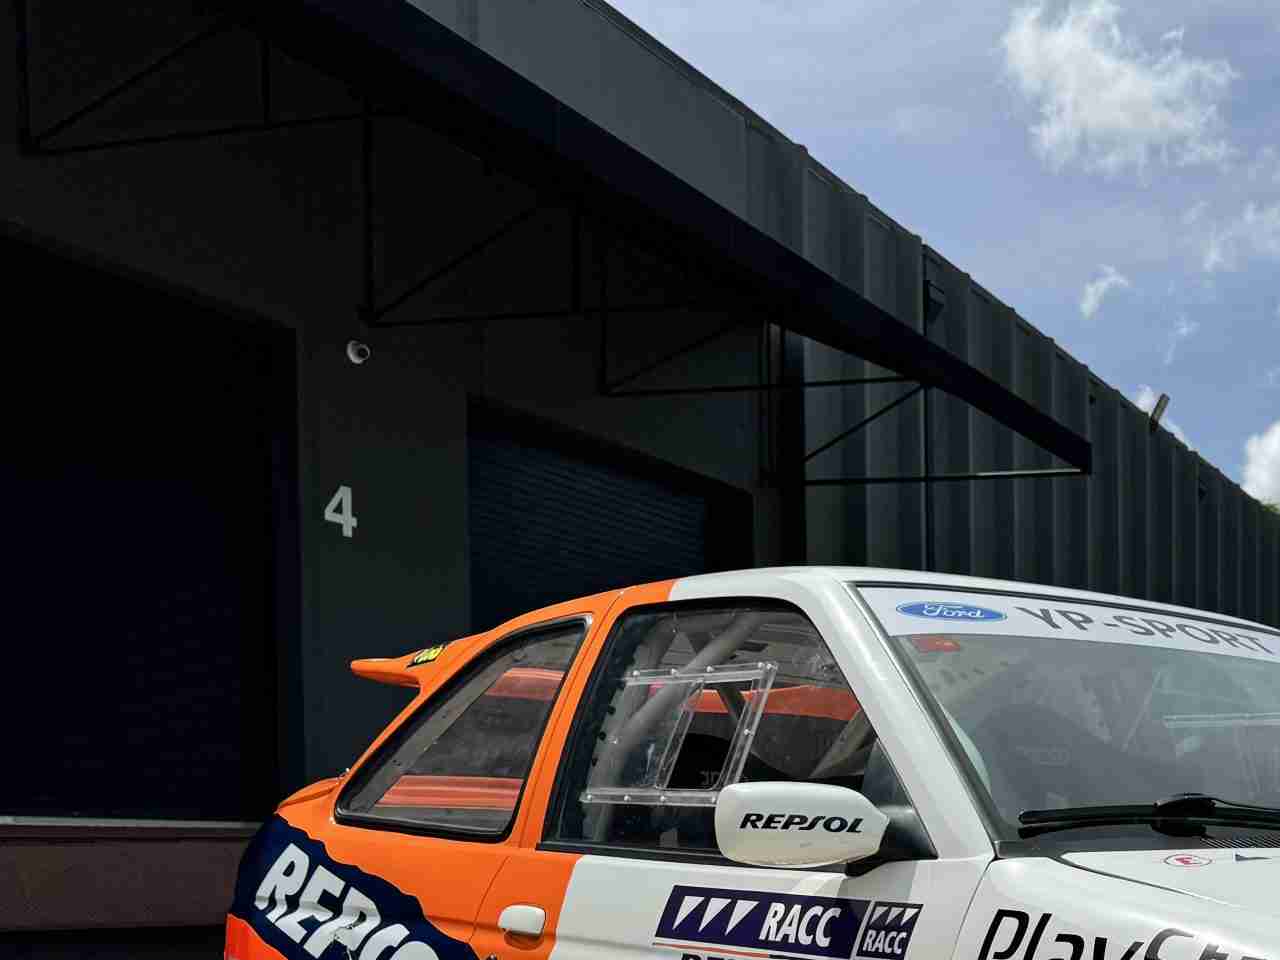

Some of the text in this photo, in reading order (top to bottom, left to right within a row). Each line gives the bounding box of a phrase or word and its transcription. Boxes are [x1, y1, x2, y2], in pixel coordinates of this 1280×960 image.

[324, 485, 358, 538] 4
[922, 602, 985, 618] Ford
[739, 813, 864, 834] REPSOL
[759, 902, 841, 948] RACC
[863, 929, 908, 955] RACC
